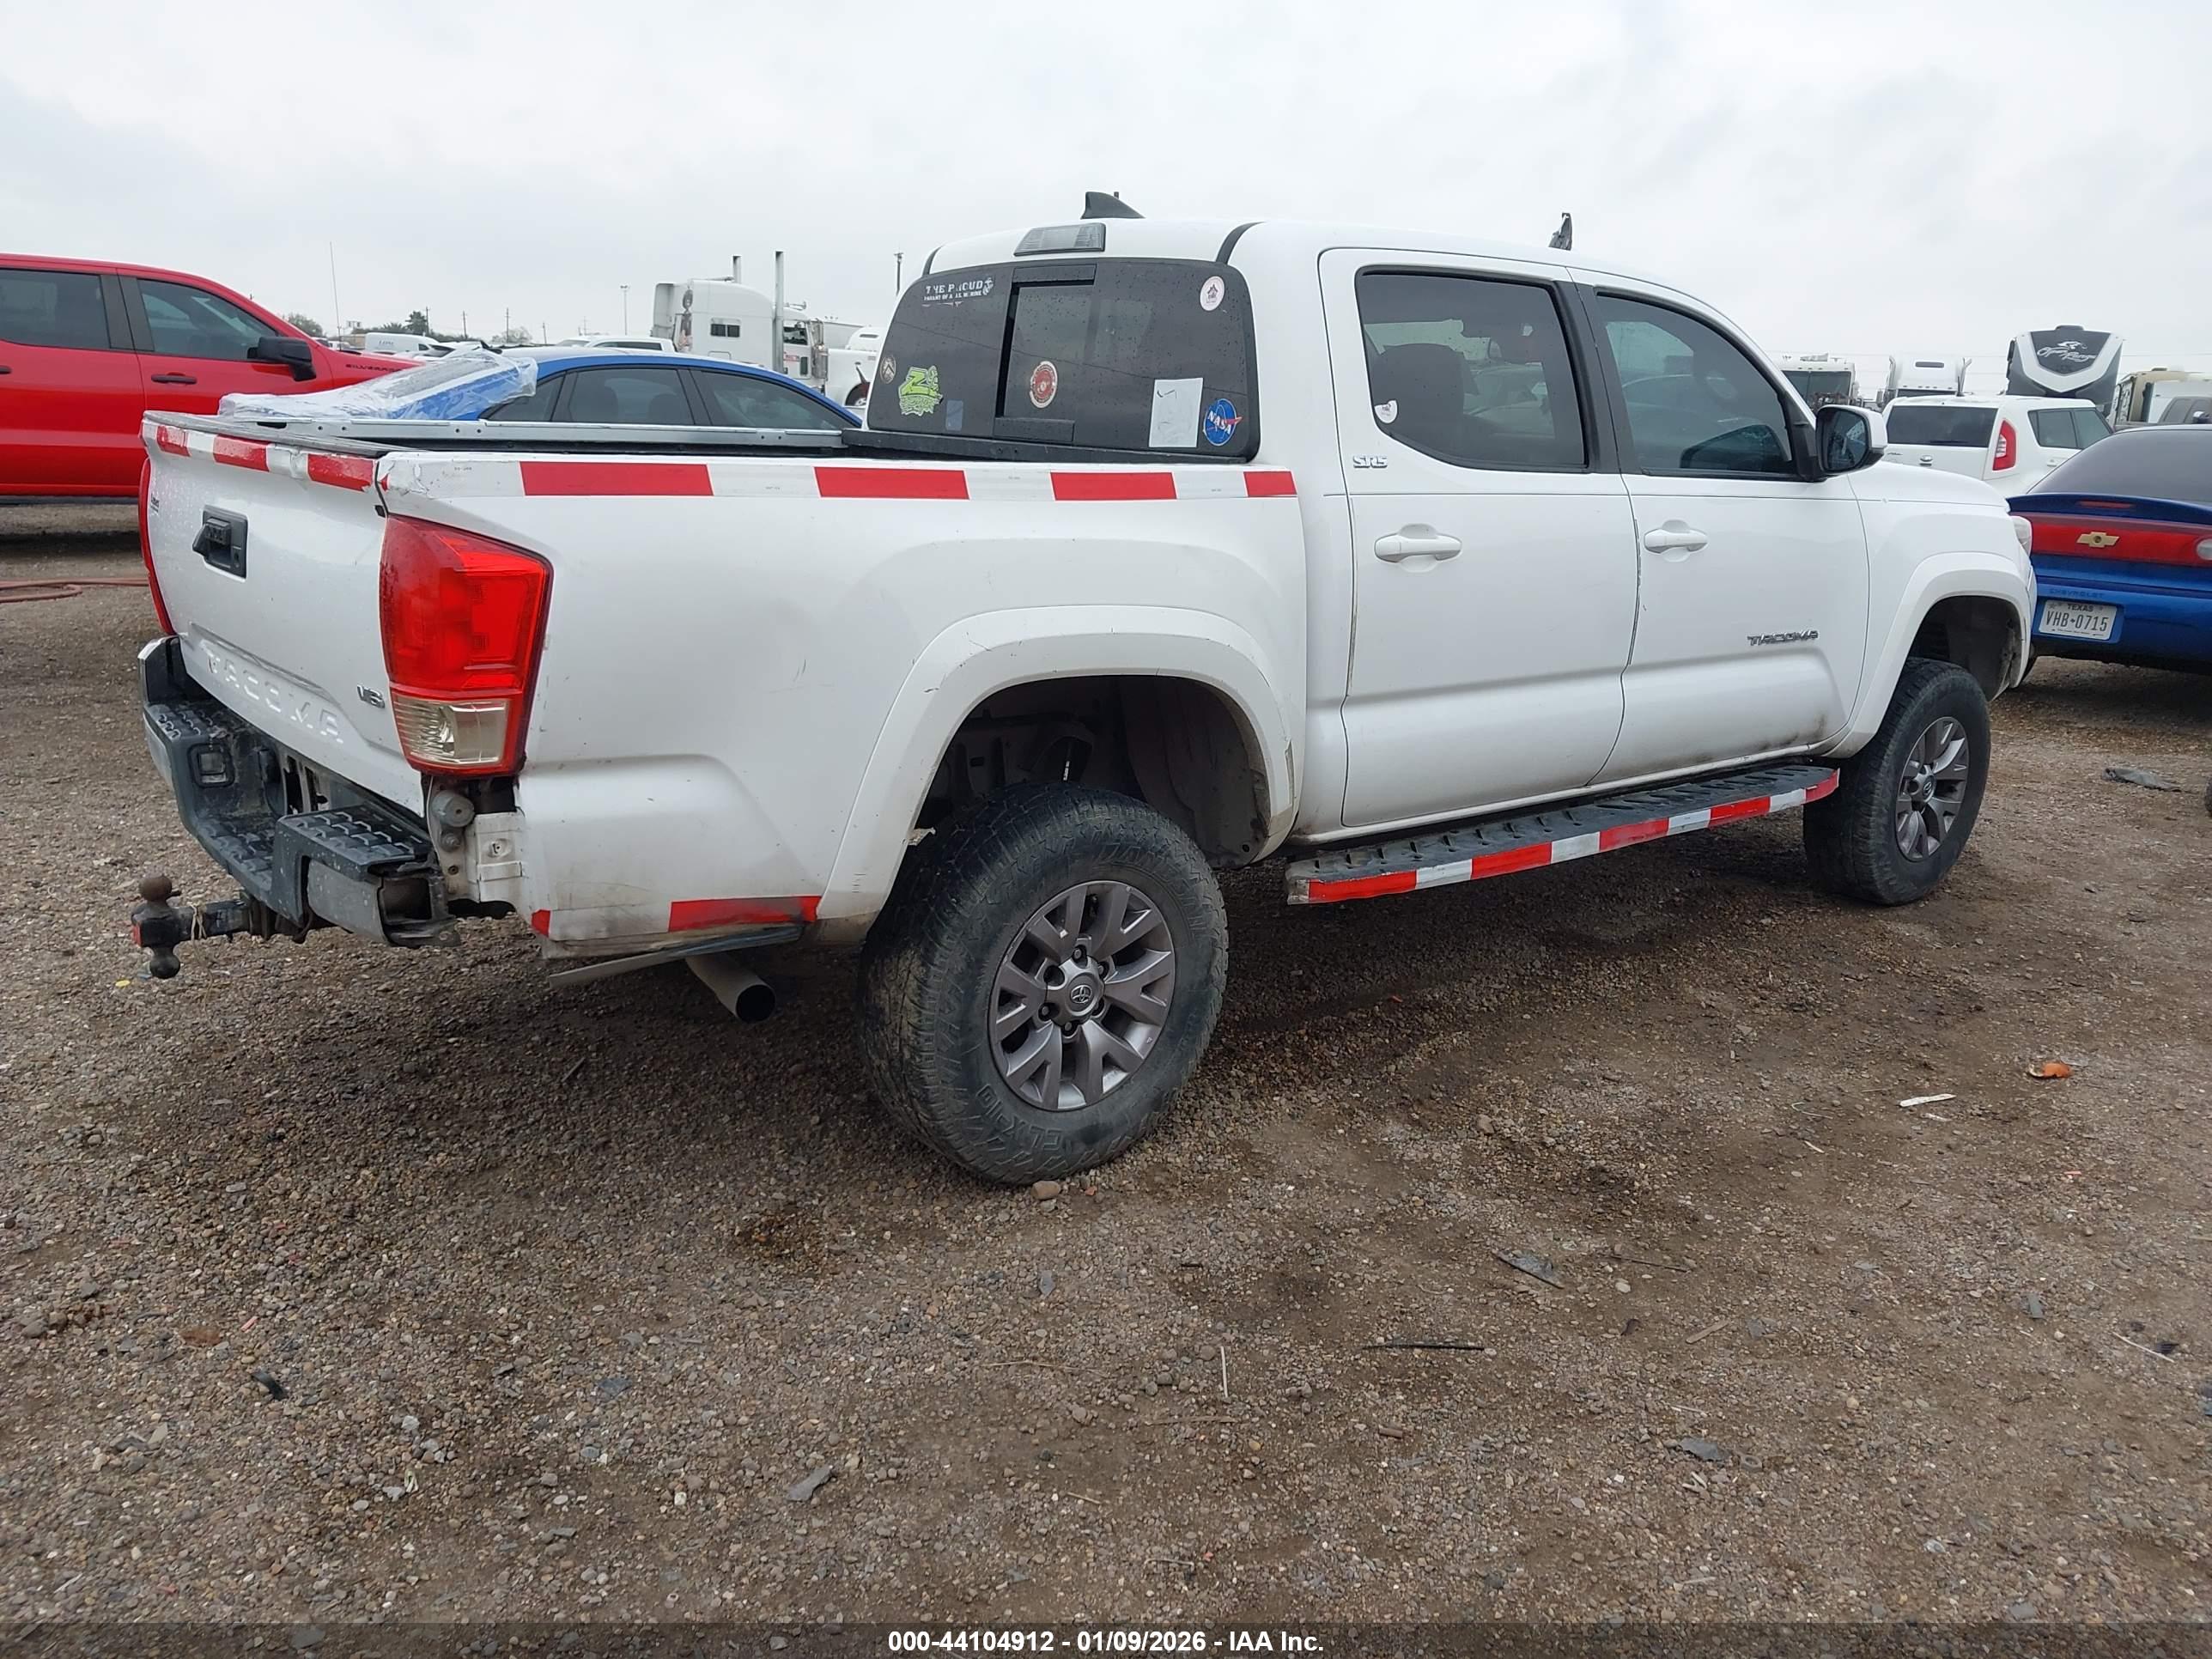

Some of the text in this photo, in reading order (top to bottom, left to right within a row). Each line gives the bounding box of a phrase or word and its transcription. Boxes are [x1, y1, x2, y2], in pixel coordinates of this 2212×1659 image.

[1207, 410, 1232, 435] NASA
[2067, 604, 2094, 612] TEXAS
[1747, 629, 1819, 646] TACOMA
[356, 684, 386, 709] V6
